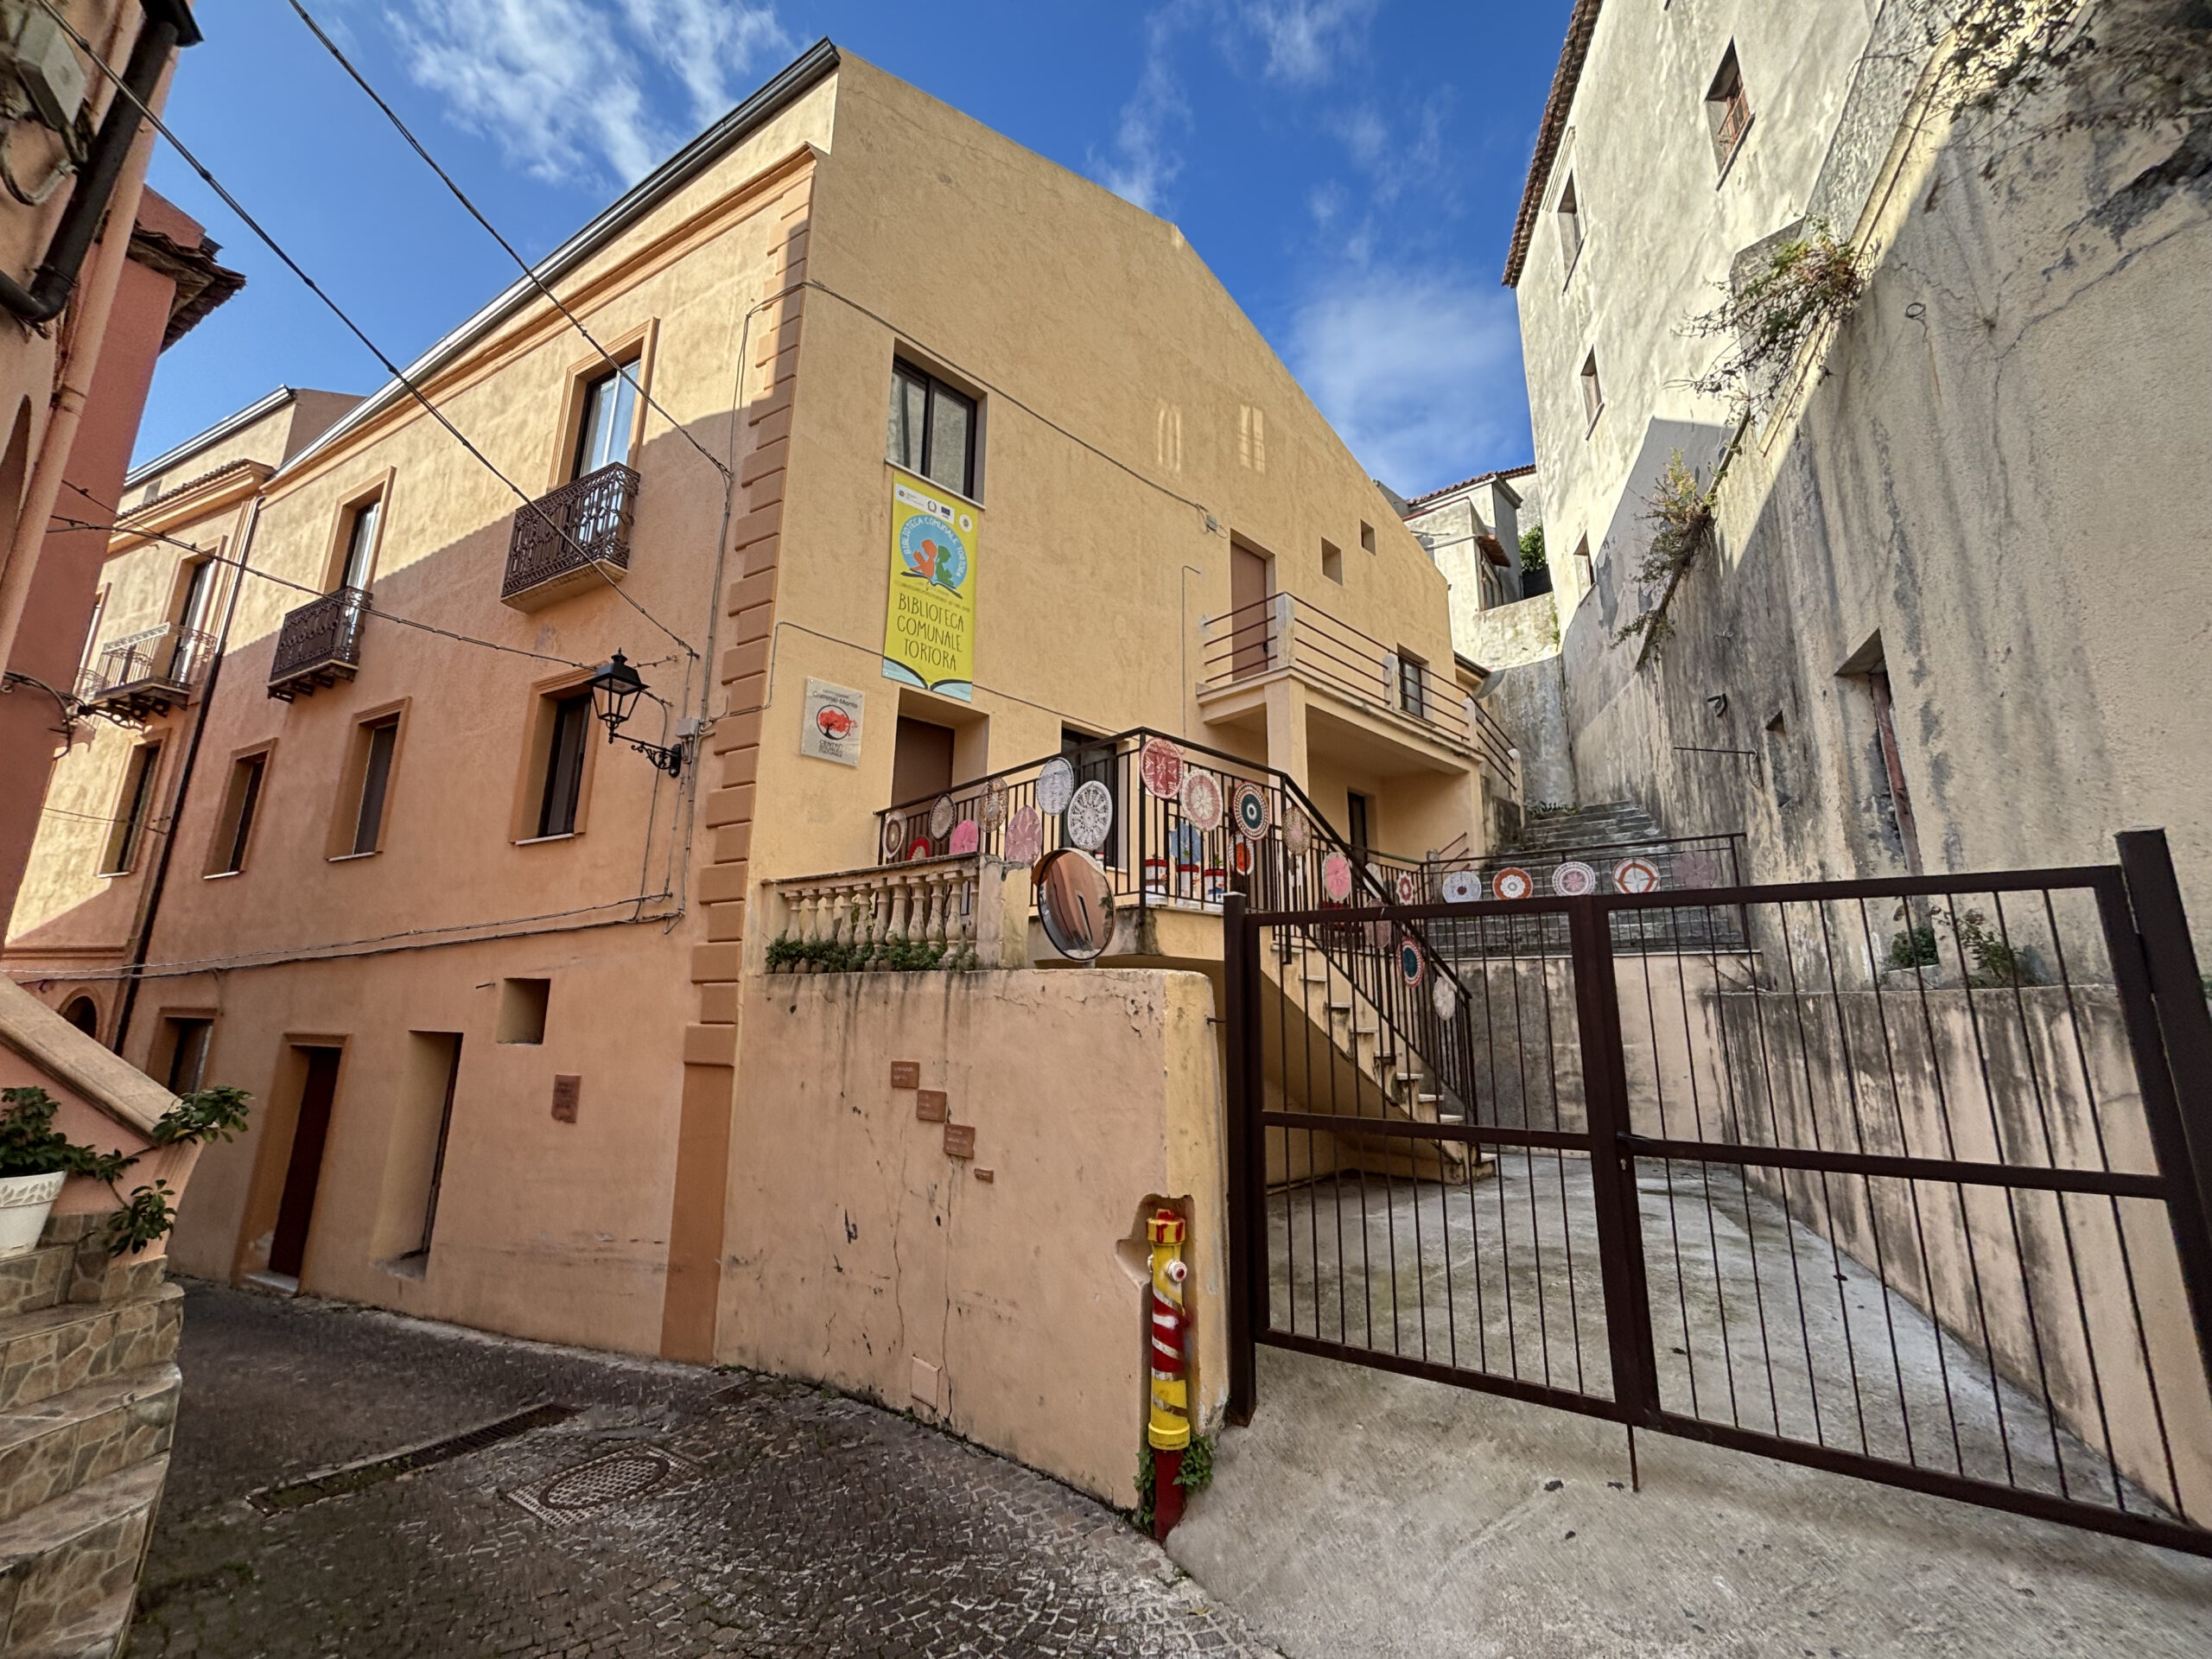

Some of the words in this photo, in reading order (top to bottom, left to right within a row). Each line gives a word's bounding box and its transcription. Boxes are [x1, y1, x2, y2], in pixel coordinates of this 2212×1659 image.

[901, 517, 925, 555] BIBLIOTECA
[925, 517, 959, 544] COMUNALE
[898, 593, 964, 632] BIBLIOTECA
[897, 615, 963, 652] COMUNALE
[904, 639, 957, 671] TORTORA
